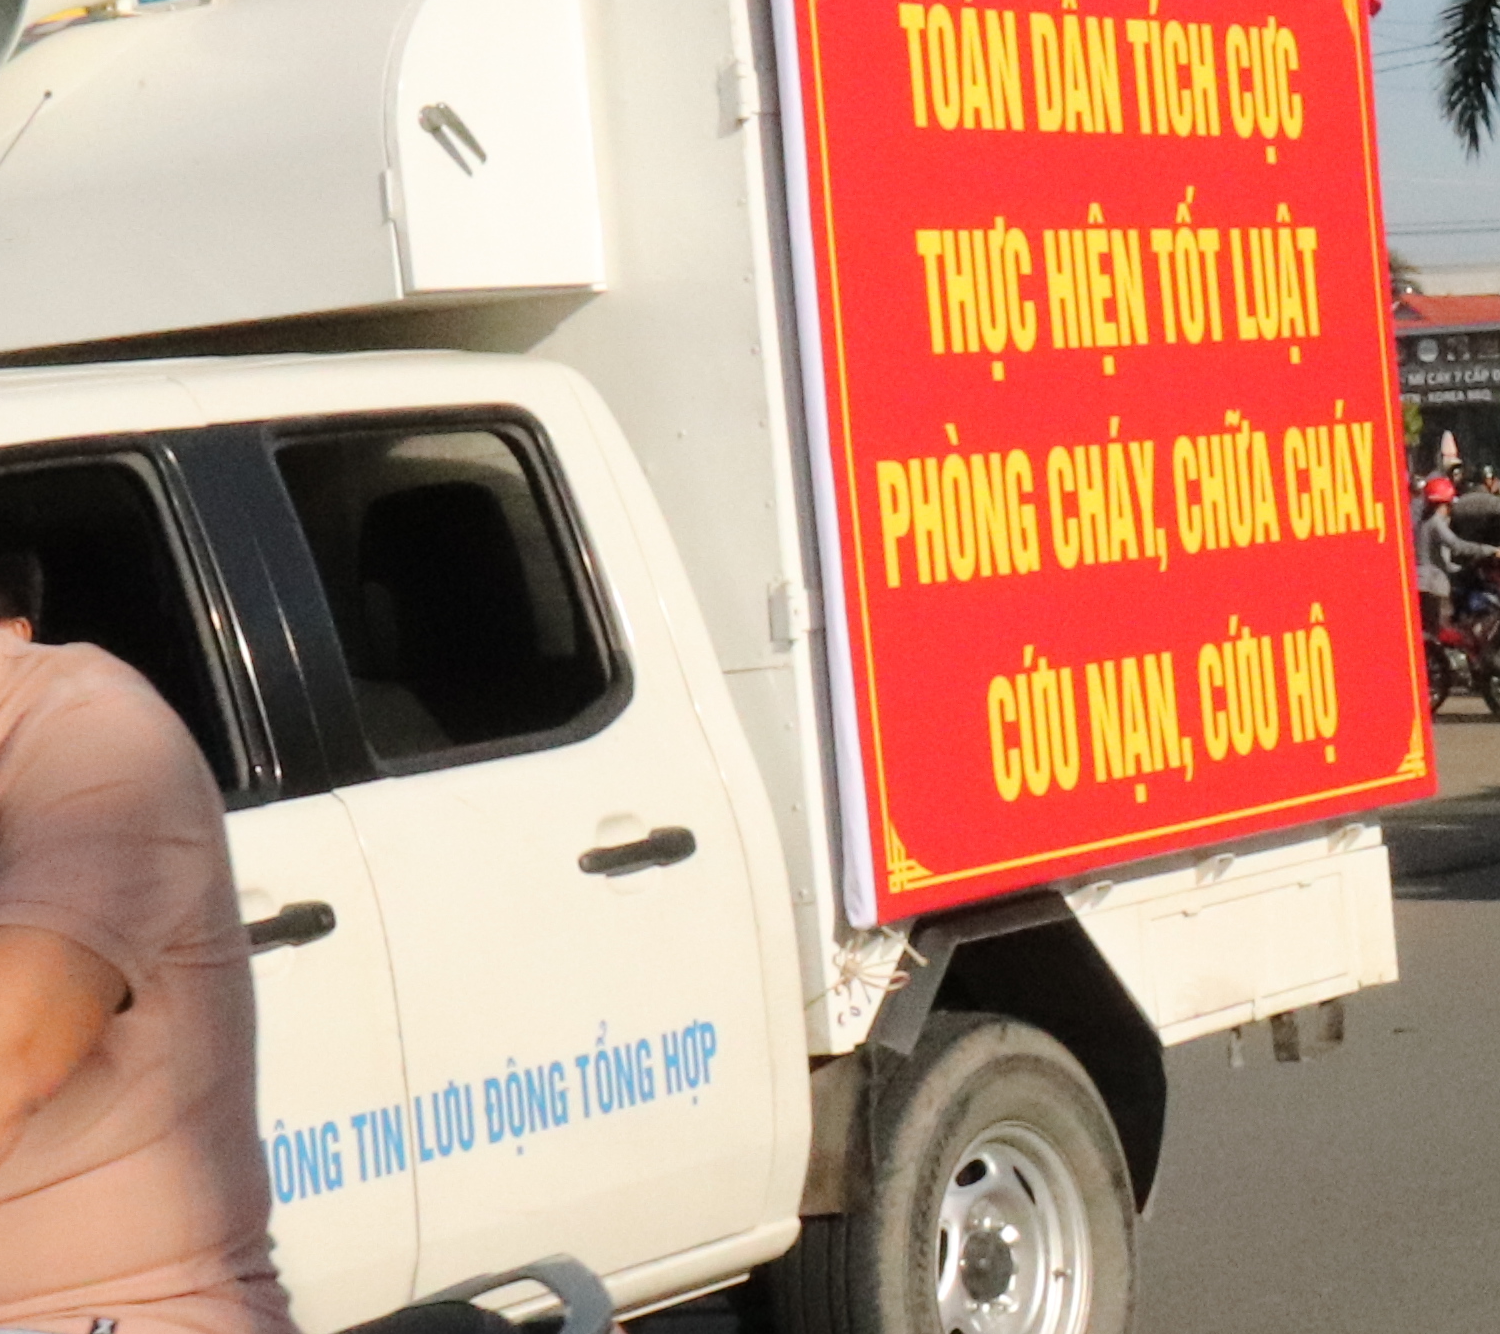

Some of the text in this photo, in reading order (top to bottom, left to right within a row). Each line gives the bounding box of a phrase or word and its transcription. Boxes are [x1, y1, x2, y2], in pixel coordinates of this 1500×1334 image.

[1226, 16, 1302, 164] CỰC
[916, 186, 1320, 381] THỰC HIỆN TỐT LUẬT
[876, 399, 1385, 588] PHÒNG CHÁY, CHỮA CHÁY,
[988, 602, 1338, 803] CỨU NẠN, CỨU HỘ
[261, 1018, 717, 1204] ÔNG TIN LƯU ĐỘNG TỔNG HỢP
